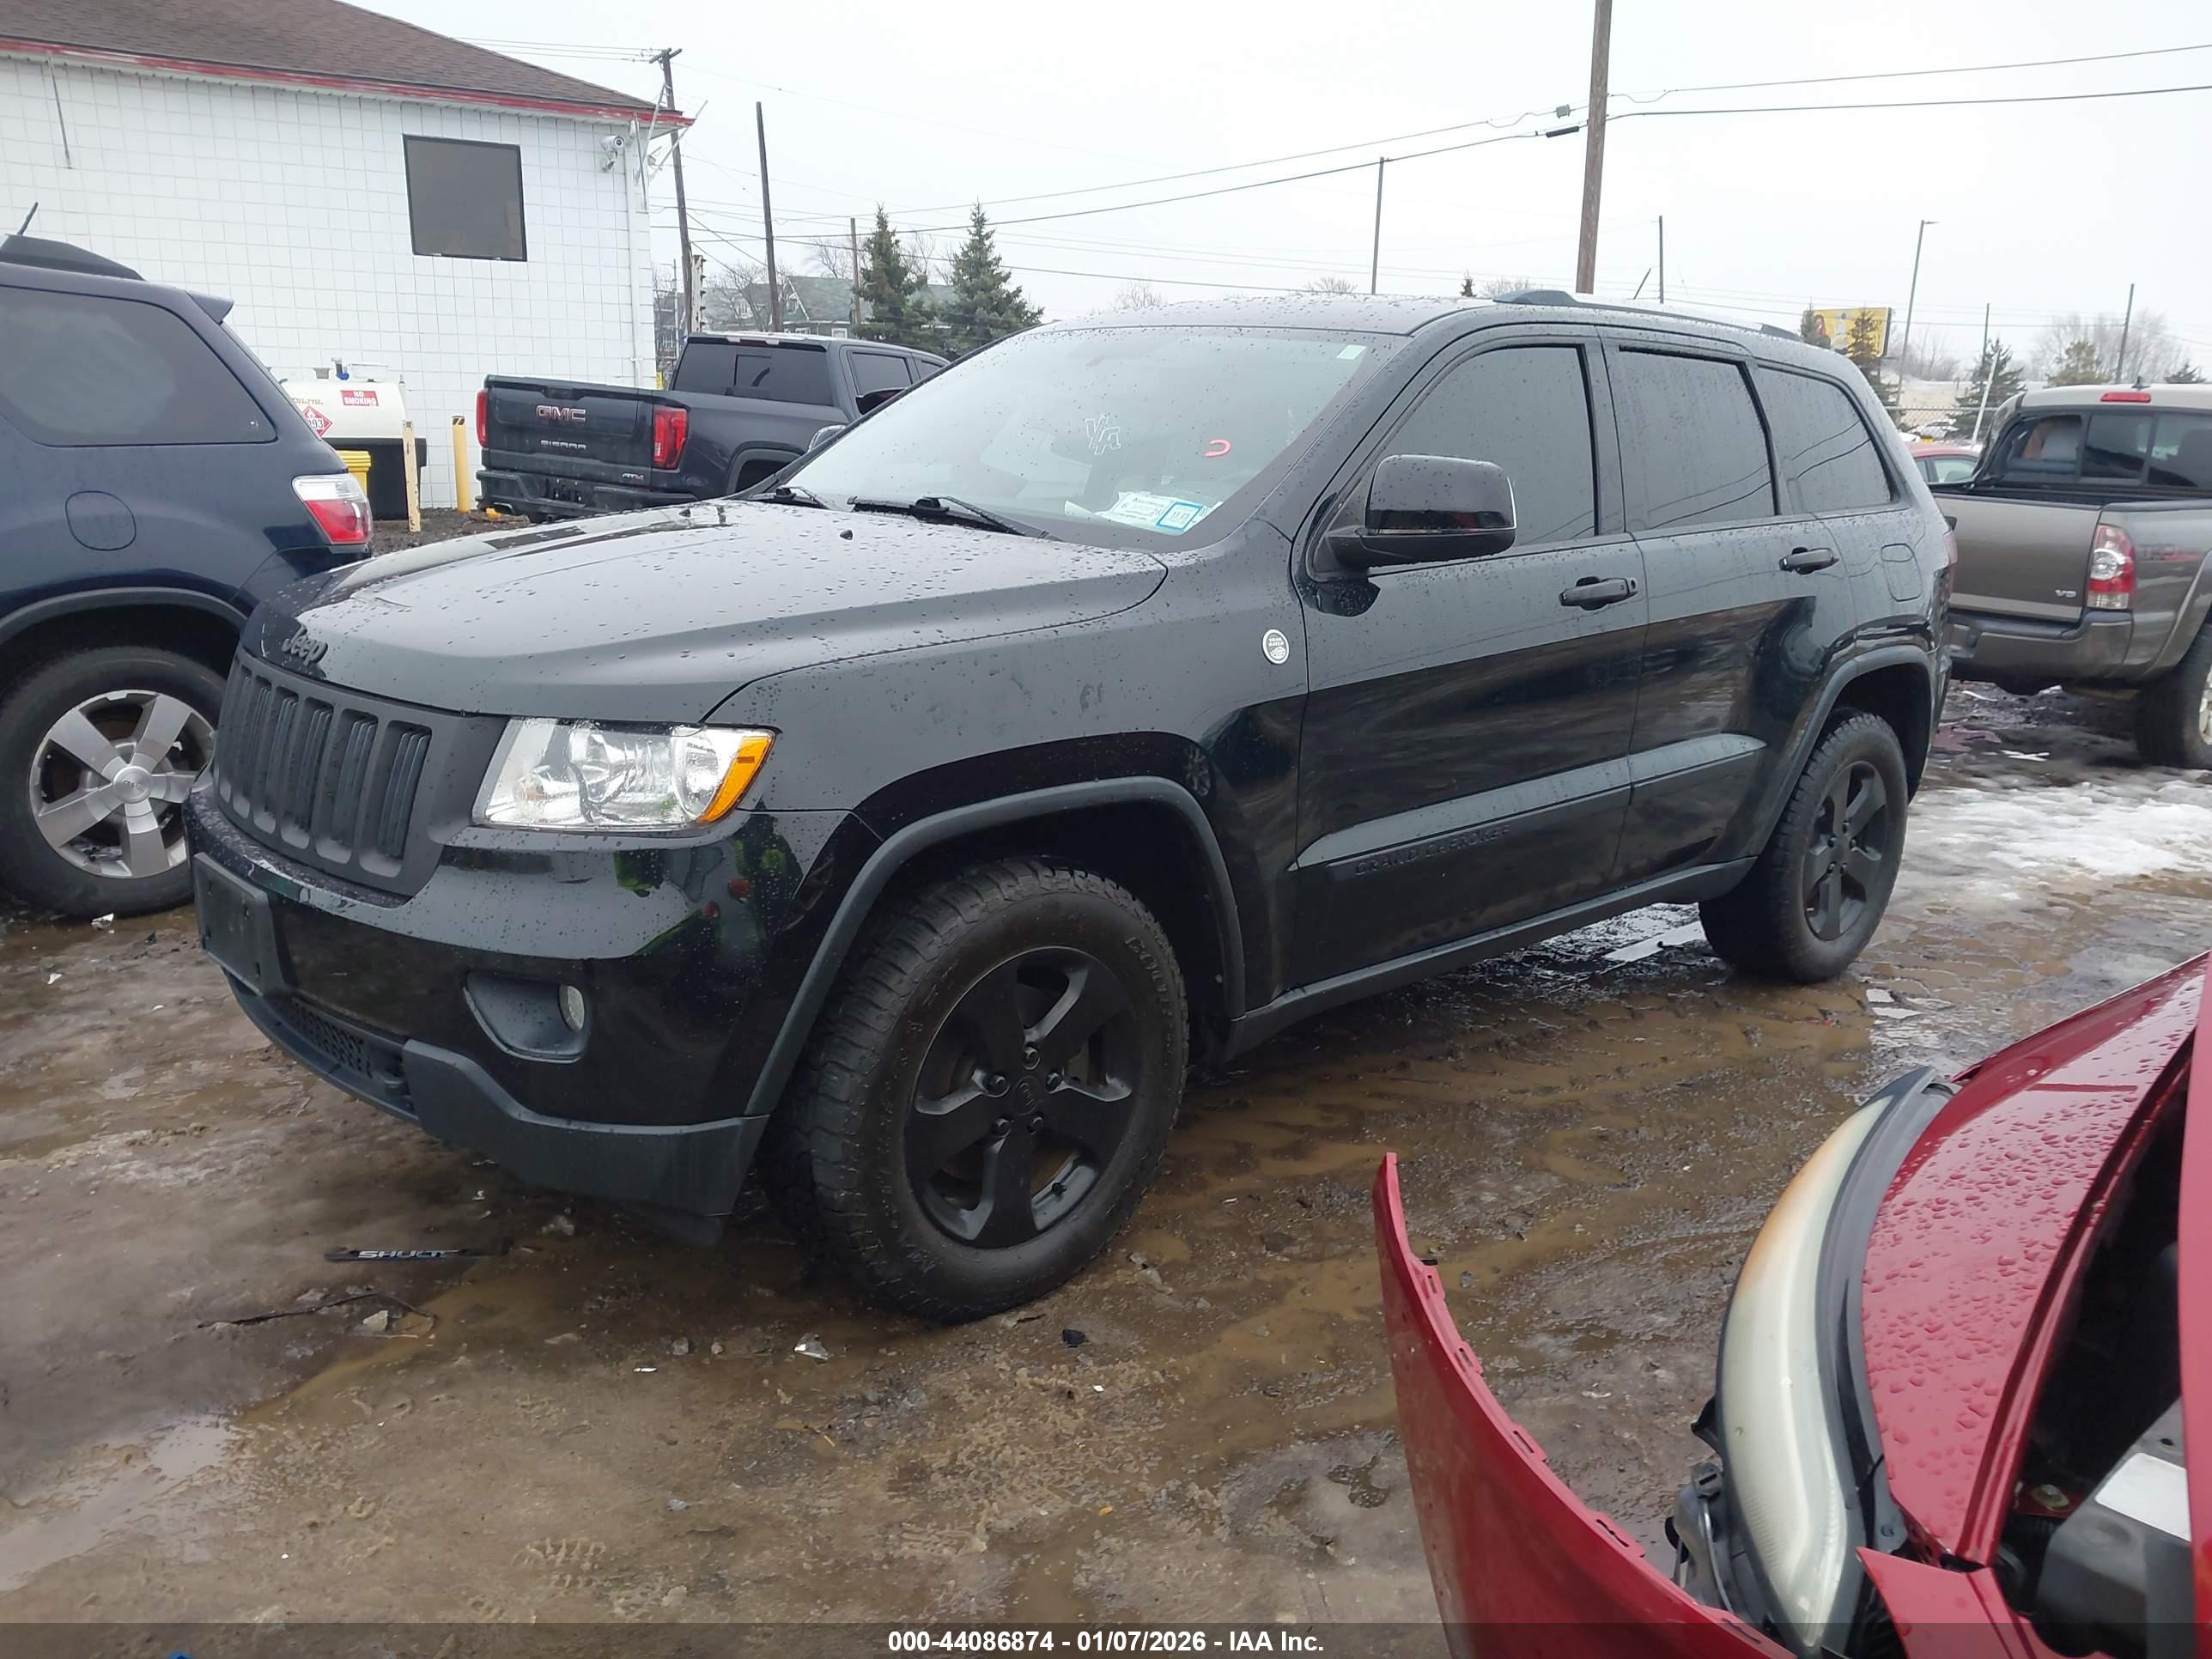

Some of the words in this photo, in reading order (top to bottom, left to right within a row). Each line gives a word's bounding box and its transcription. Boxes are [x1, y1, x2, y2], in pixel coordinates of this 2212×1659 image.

[343, 397, 377, 406] SMOKING
[536, 405, 586, 422] GMC
[540, 440, 586, 450] SIERRA
[2055, 589, 2077, 598] V6
[281, 624, 328, 666] Jeep
